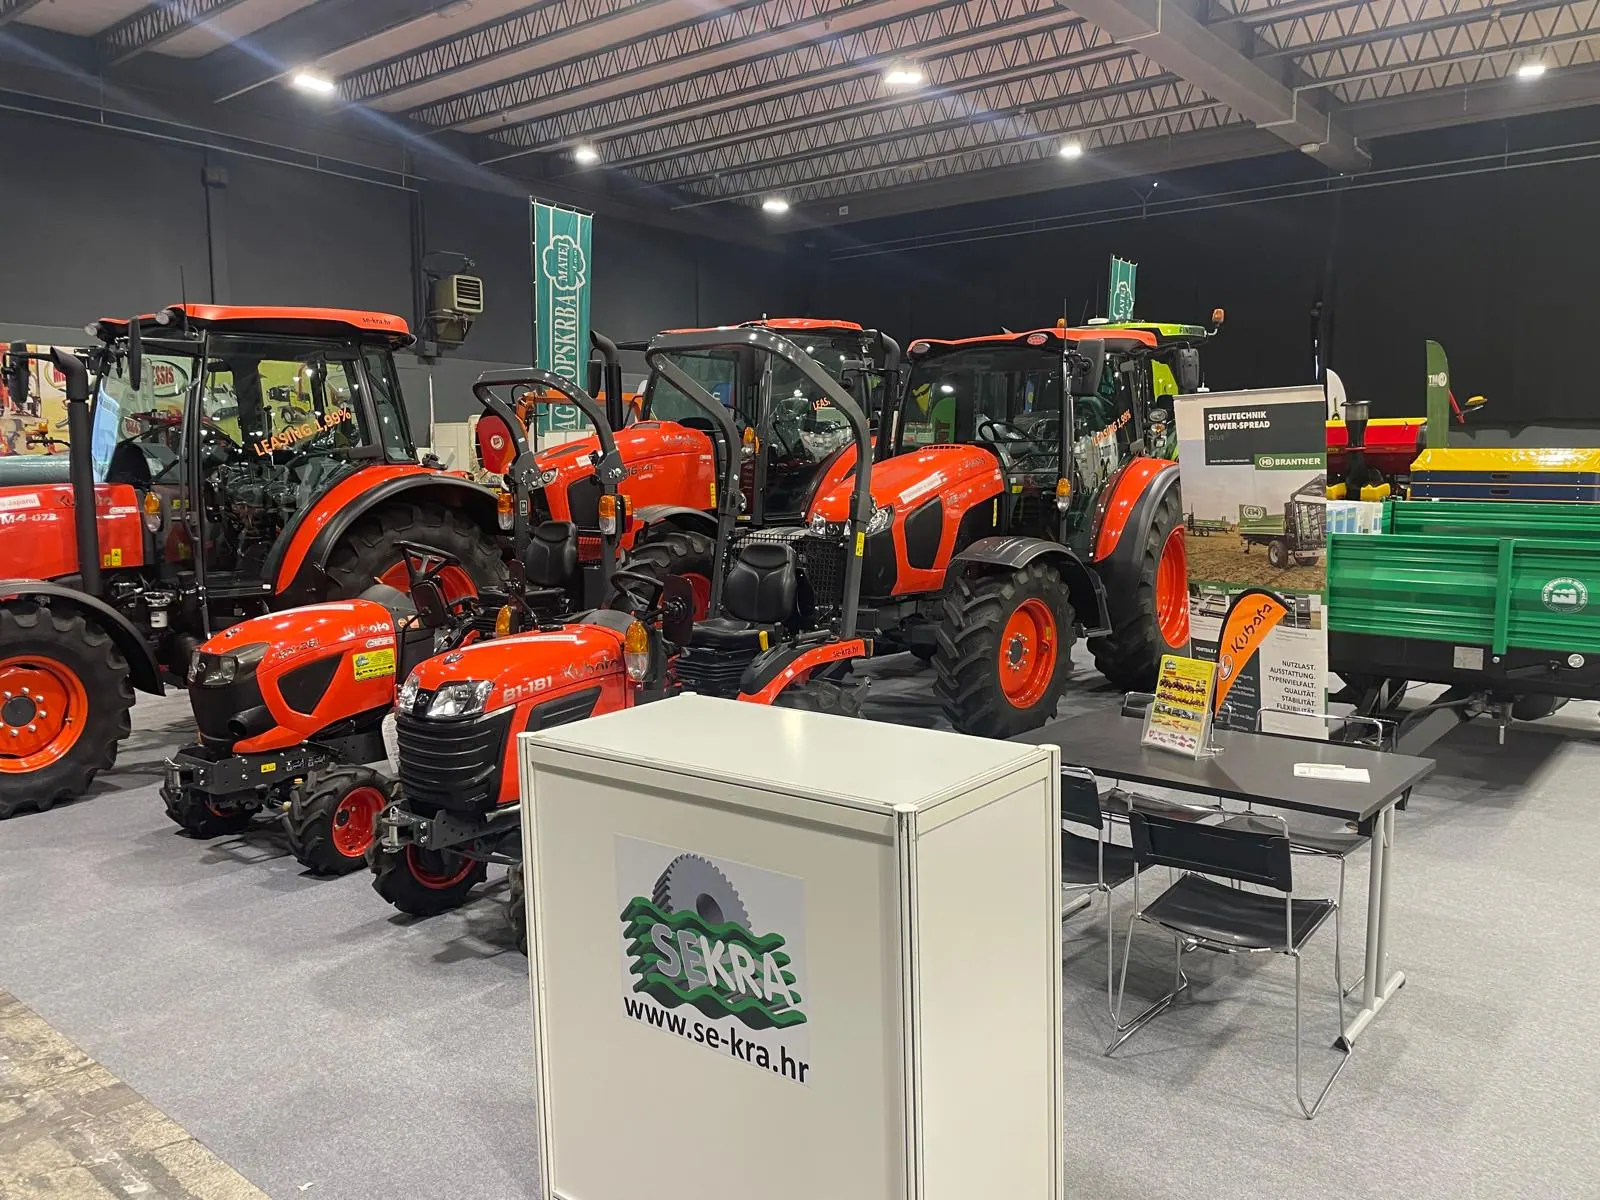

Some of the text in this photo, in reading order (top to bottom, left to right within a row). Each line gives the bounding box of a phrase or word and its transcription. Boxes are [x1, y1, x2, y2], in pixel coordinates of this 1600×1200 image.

[558, 241, 570, 282] MATEJ
[554, 295, 577, 431] AGOPSKRBA
[813, 397, 831, 411] LEAS
[1208, 411, 1267, 421] STREUTECHNIK
[254, 407, 352, 456] LEASING 1,99%
[1208, 421, 1270, 430] POWER-SPREAD
[1092, 421, 1118, 447] LEASING
[1275, 457, 1321, 466] BRANTNER
[1230, 603, 1273, 653] Kubota
[1282, 660, 1316, 671] NUTZLAST.
[1269, 666, 1316, 680] AUSSTATTUNG.
[502, 675, 553, 703] B1-181
[1267, 675, 1316, 689] TYPENVIELFALT.
[1283, 687, 1317, 699] QUALITÄT.
[1281, 694, 1317, 707] STABILITÄT.
[651, 923, 795, 1007] SEKRA
[623, 996, 809, 1083] www.se-kra.hr
